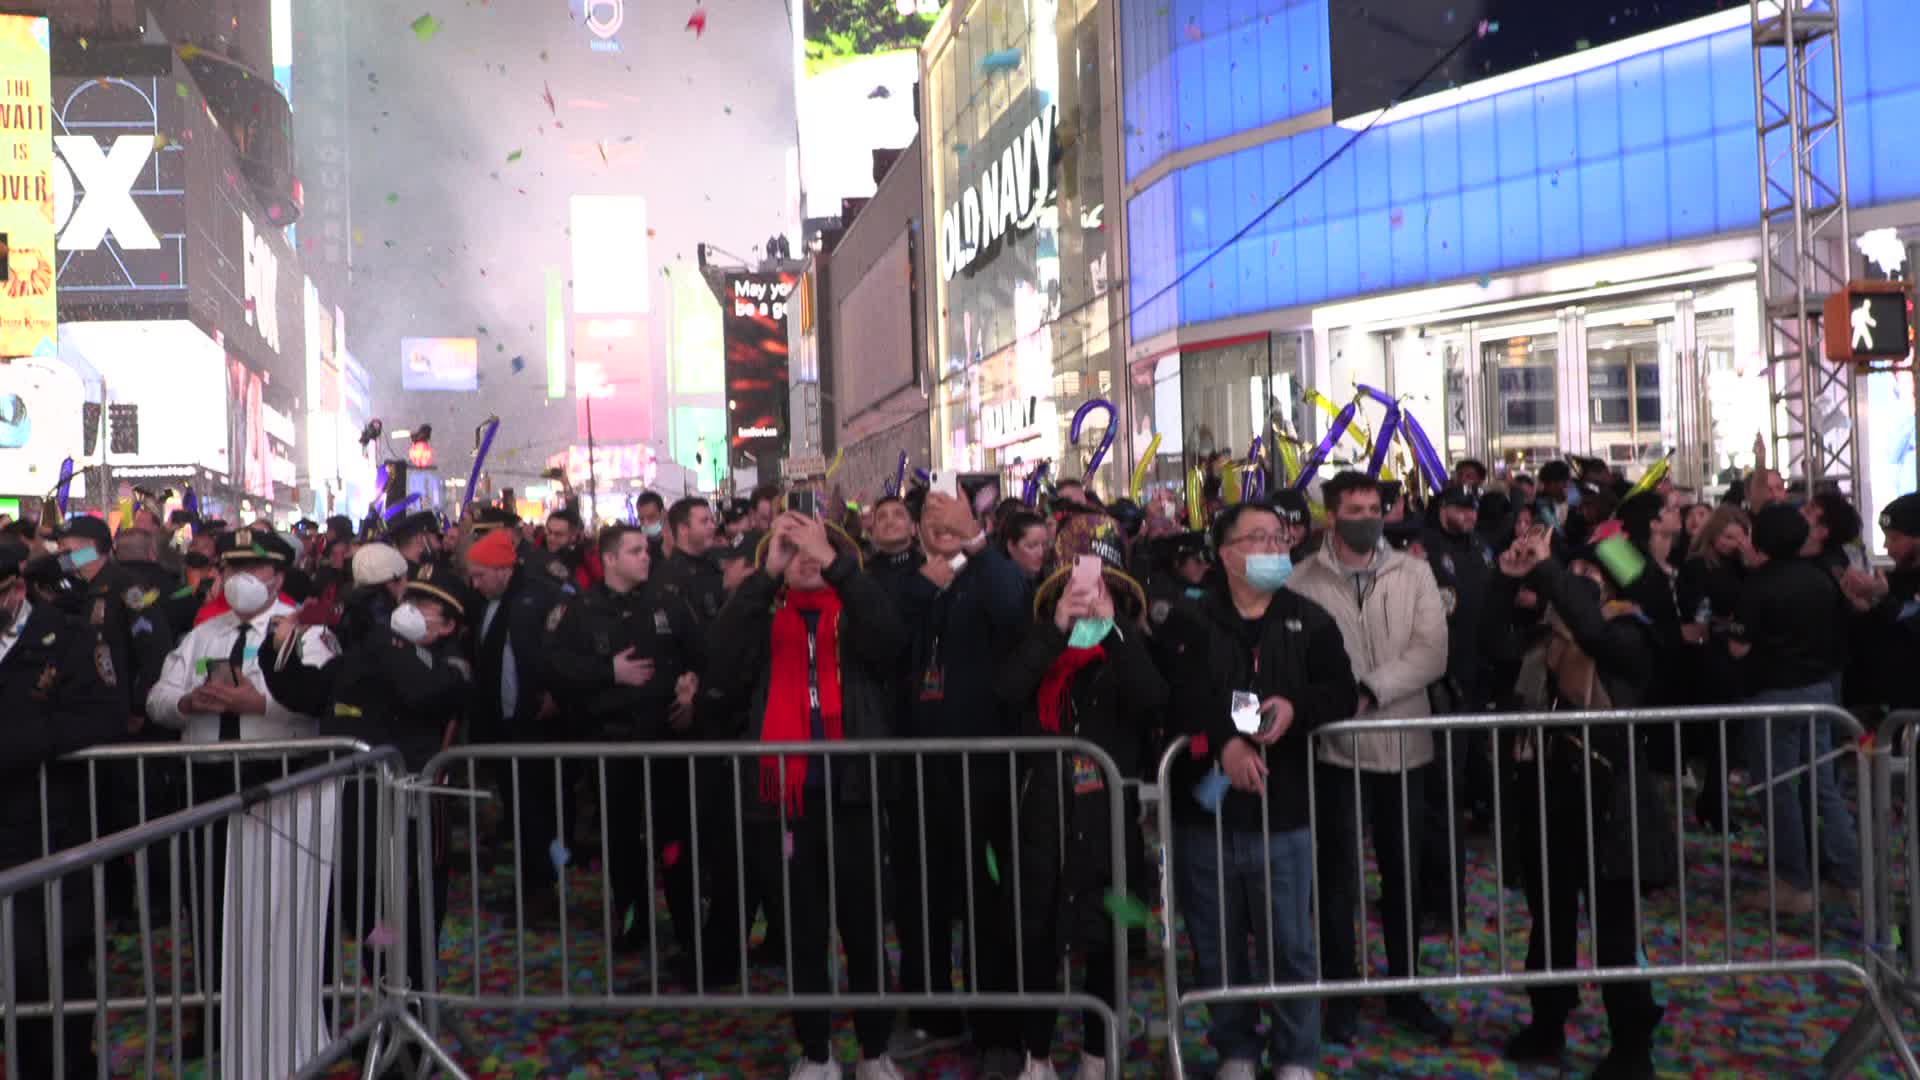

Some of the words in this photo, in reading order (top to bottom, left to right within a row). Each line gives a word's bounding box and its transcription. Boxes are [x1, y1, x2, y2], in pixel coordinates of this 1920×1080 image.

[6, 79, 31, 97] THE
[13, 143, 28, 161] IS
[942, 186, 980, 282] OLD
[980, 104, 1057, 248] NAVY
[734, 279, 768, 301] May
